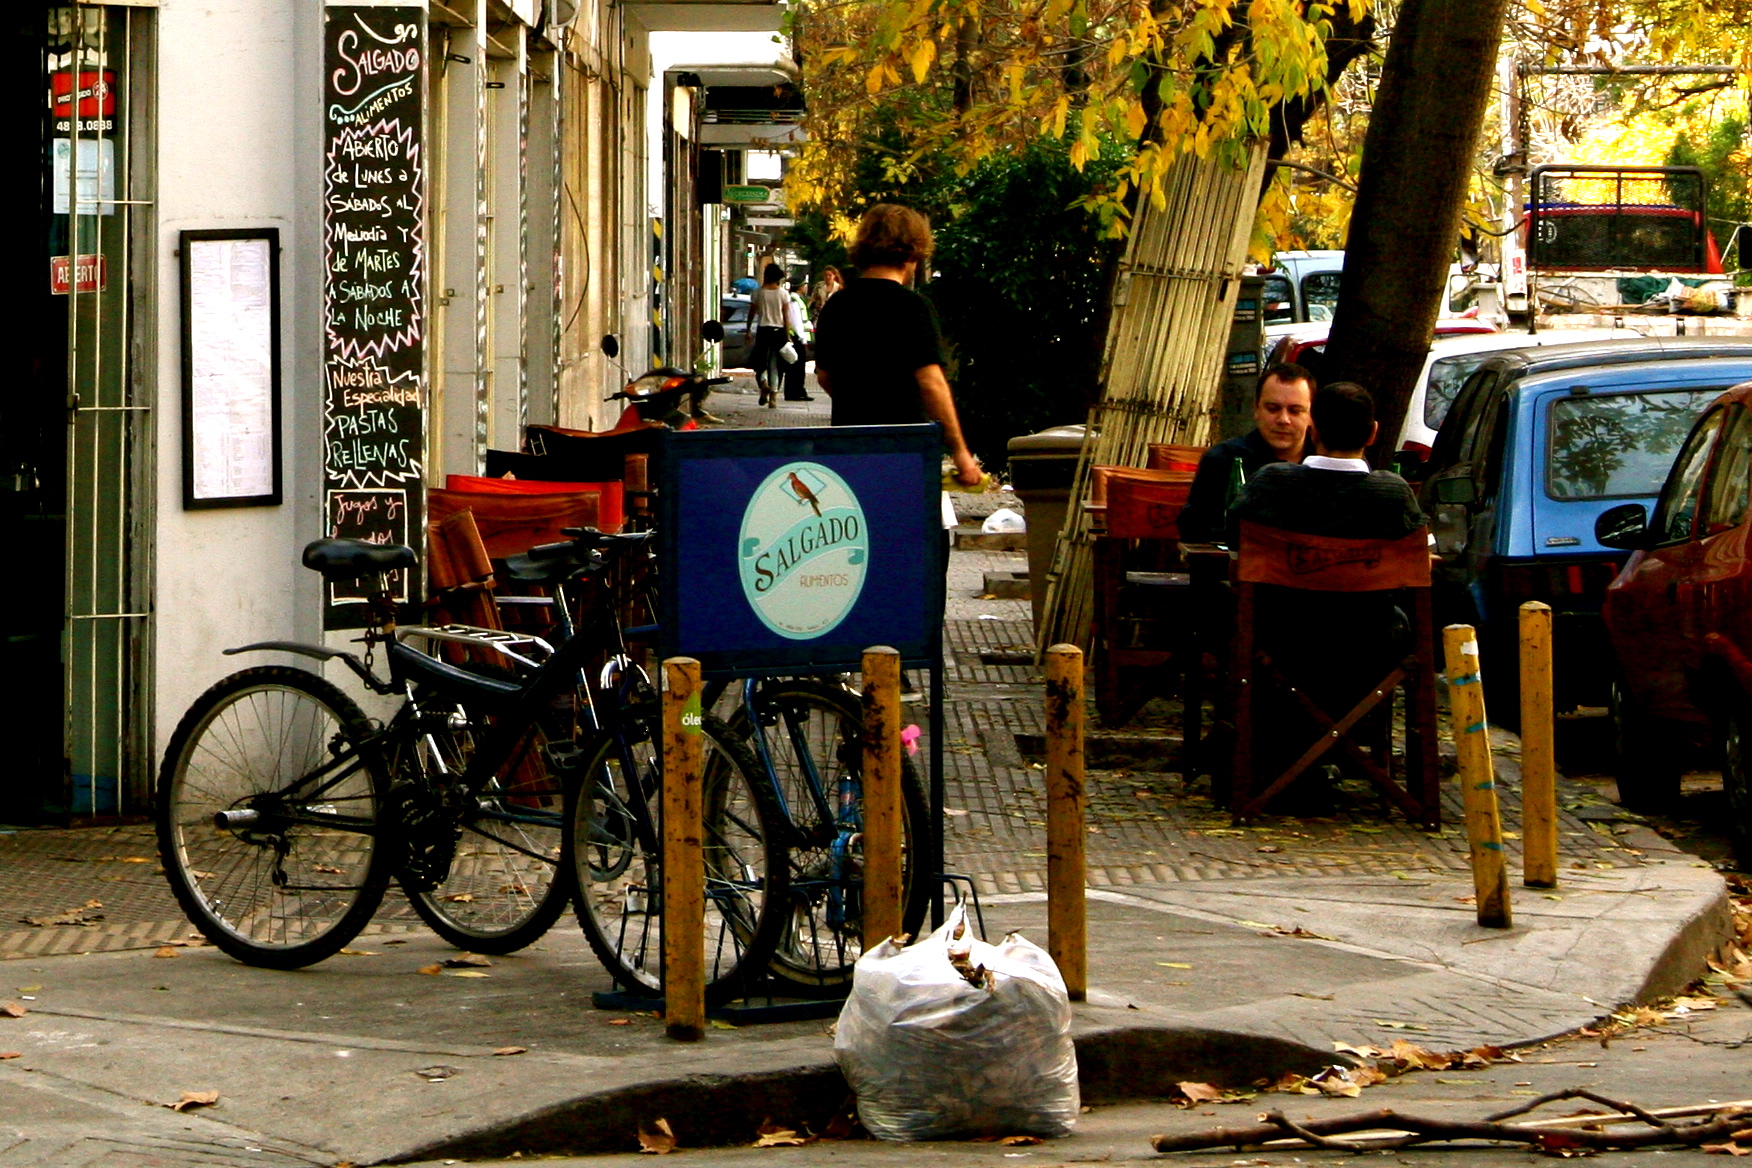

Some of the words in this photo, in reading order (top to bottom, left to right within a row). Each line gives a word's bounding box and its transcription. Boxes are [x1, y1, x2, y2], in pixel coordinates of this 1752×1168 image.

[332, 30, 420, 95] SALGADO
[334, 407, 398, 439] PASTAS
[754, 515, 859, 592] SALGADO
